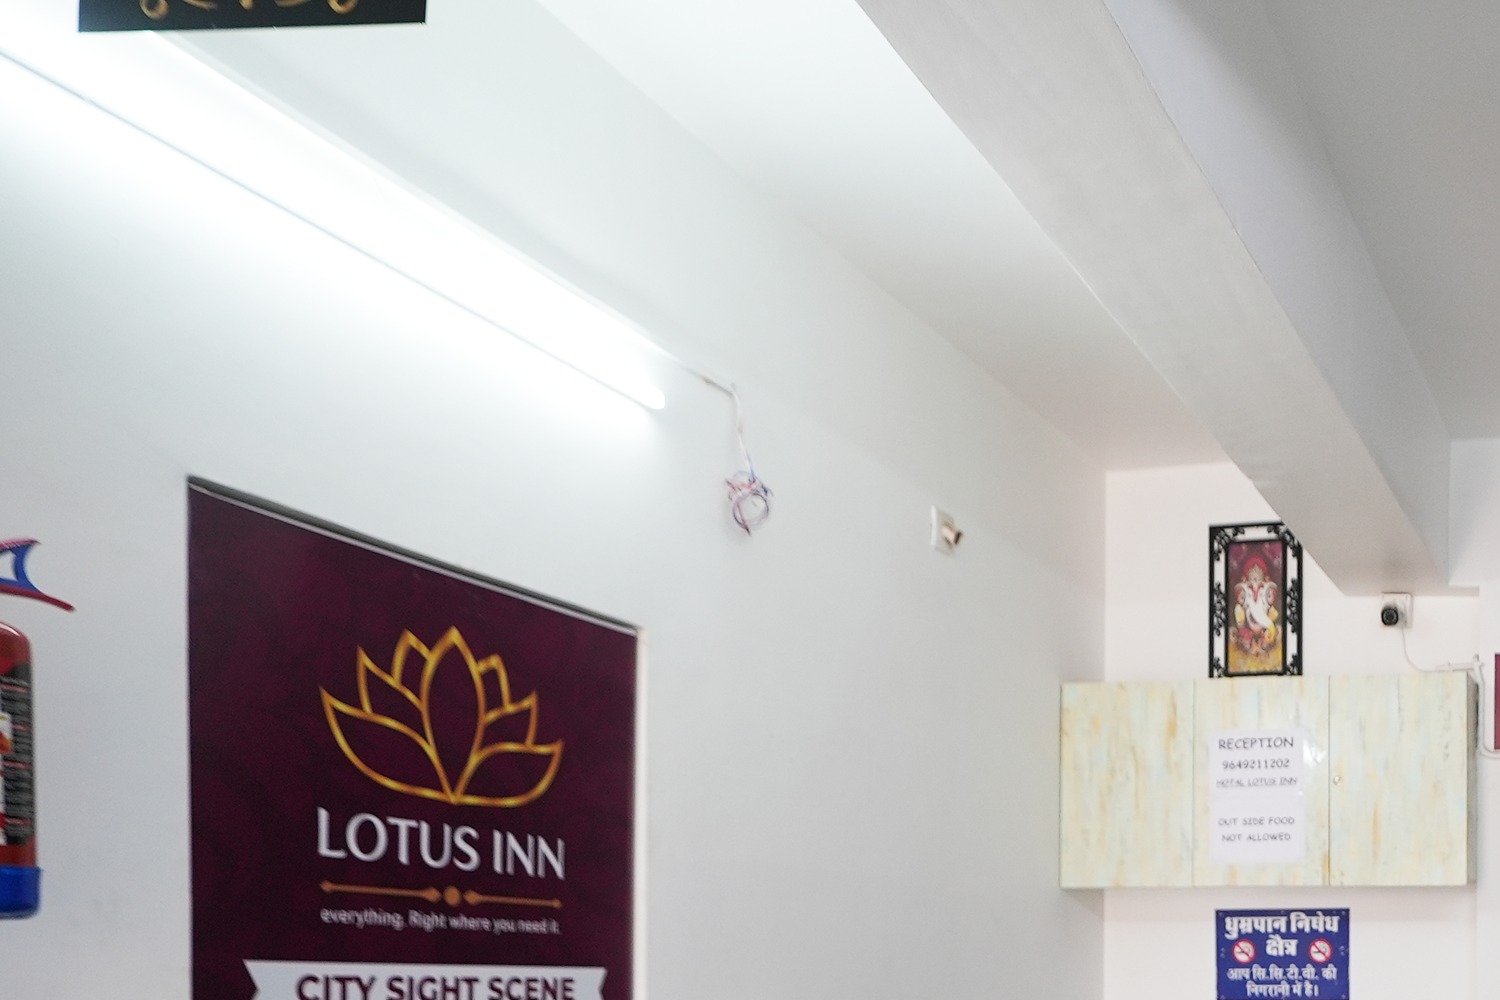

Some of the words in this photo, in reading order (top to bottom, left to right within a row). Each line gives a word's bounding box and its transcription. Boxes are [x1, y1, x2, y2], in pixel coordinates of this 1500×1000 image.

[1217, 736, 1295, 751] RECEPTION
[1217, 817, 1239, 827] OUT
[1242, 816, 1265, 827] SIDE
[1267, 815, 1295, 826] FOOD
[317, 806, 481, 872] LOTUS
[492, 828, 566, 881] INN
[1221, 833, 1242, 843] NOT
[1246, 831, 1292, 842] ALLOWED
[408, 909, 448, 933] Right
[449, 913, 492, 932] where
[491, 918, 516, 935] you
[517, 918, 547, 934] need
[1226, 966, 1251, 981] आप
